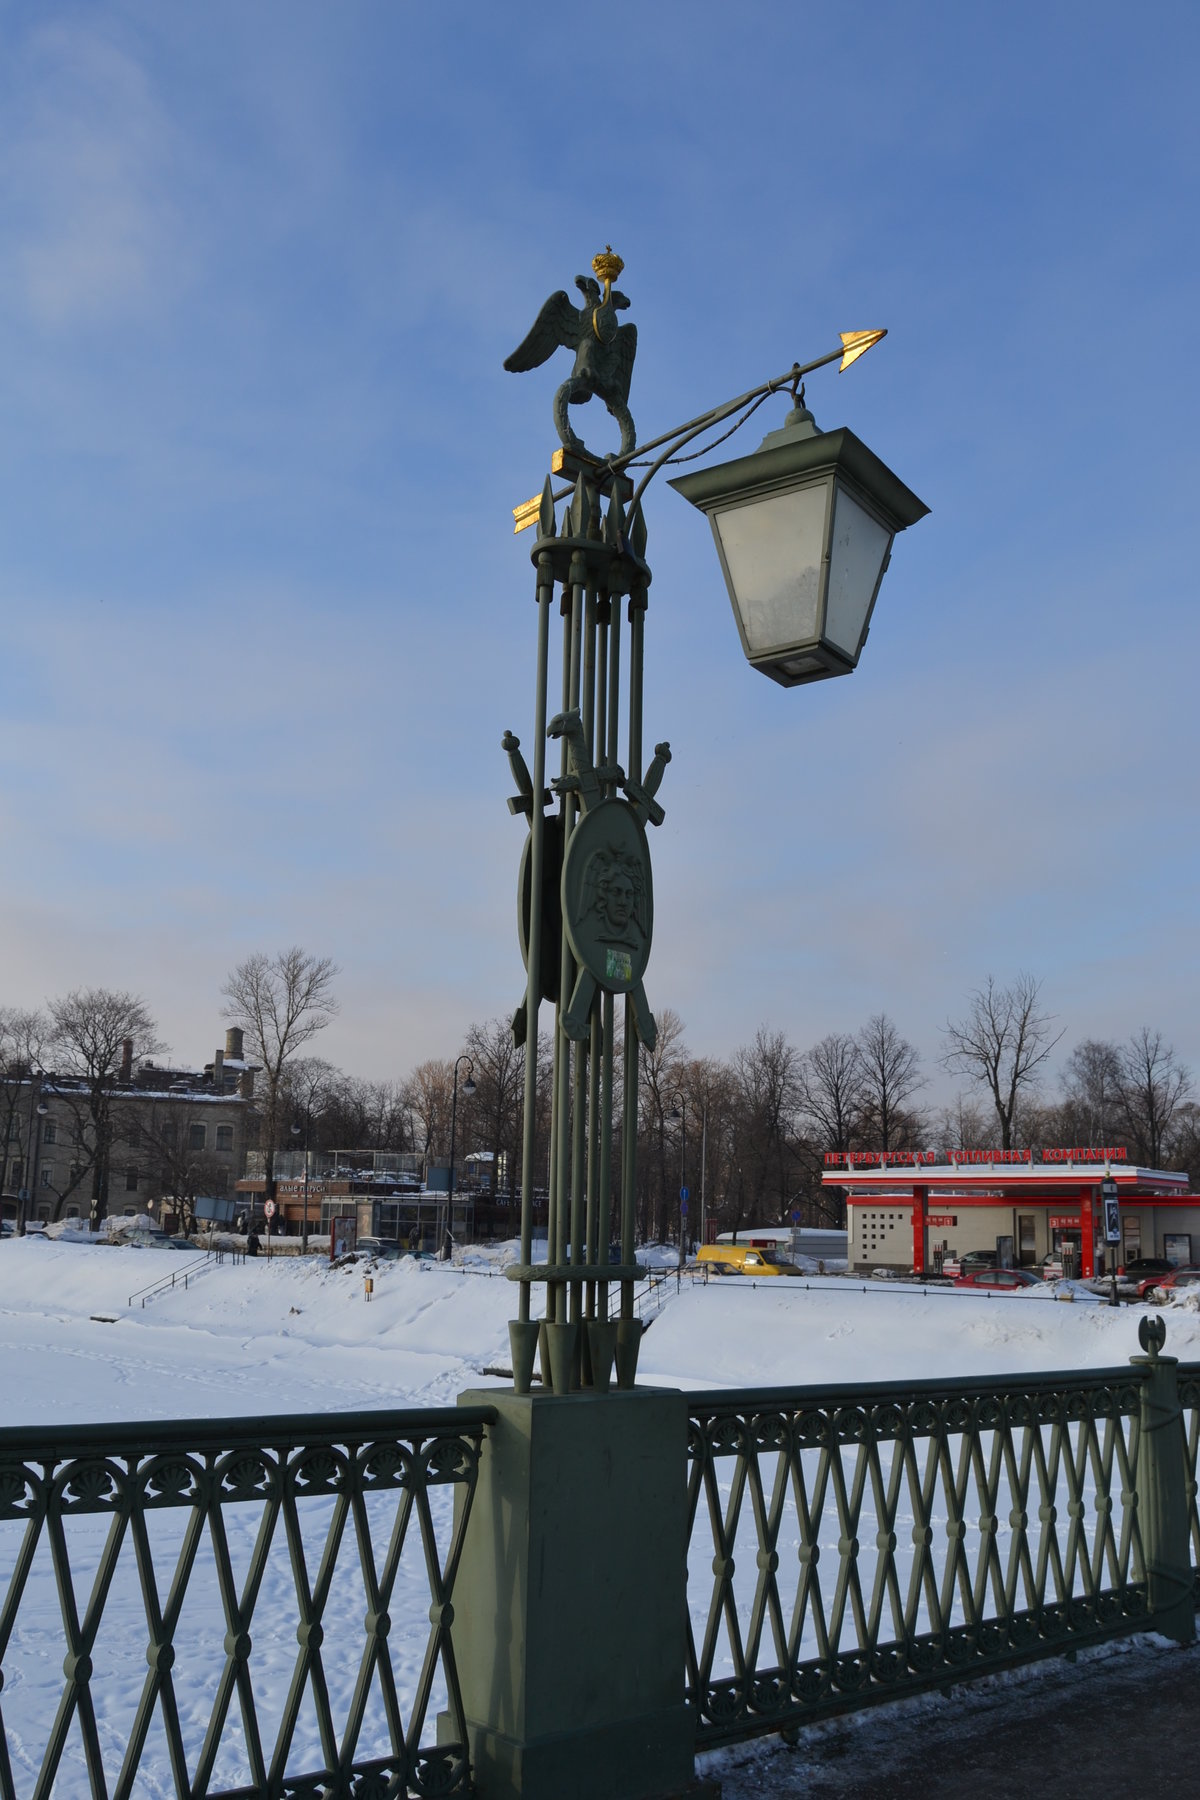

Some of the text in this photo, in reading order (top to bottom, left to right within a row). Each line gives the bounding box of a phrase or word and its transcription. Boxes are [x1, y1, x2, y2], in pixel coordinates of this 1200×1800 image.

[824, 1147, 1127, 1165] ПЕТЕРБУРГСКАЯ ТОПЛИВНАЯ КОМПАНИЯ
